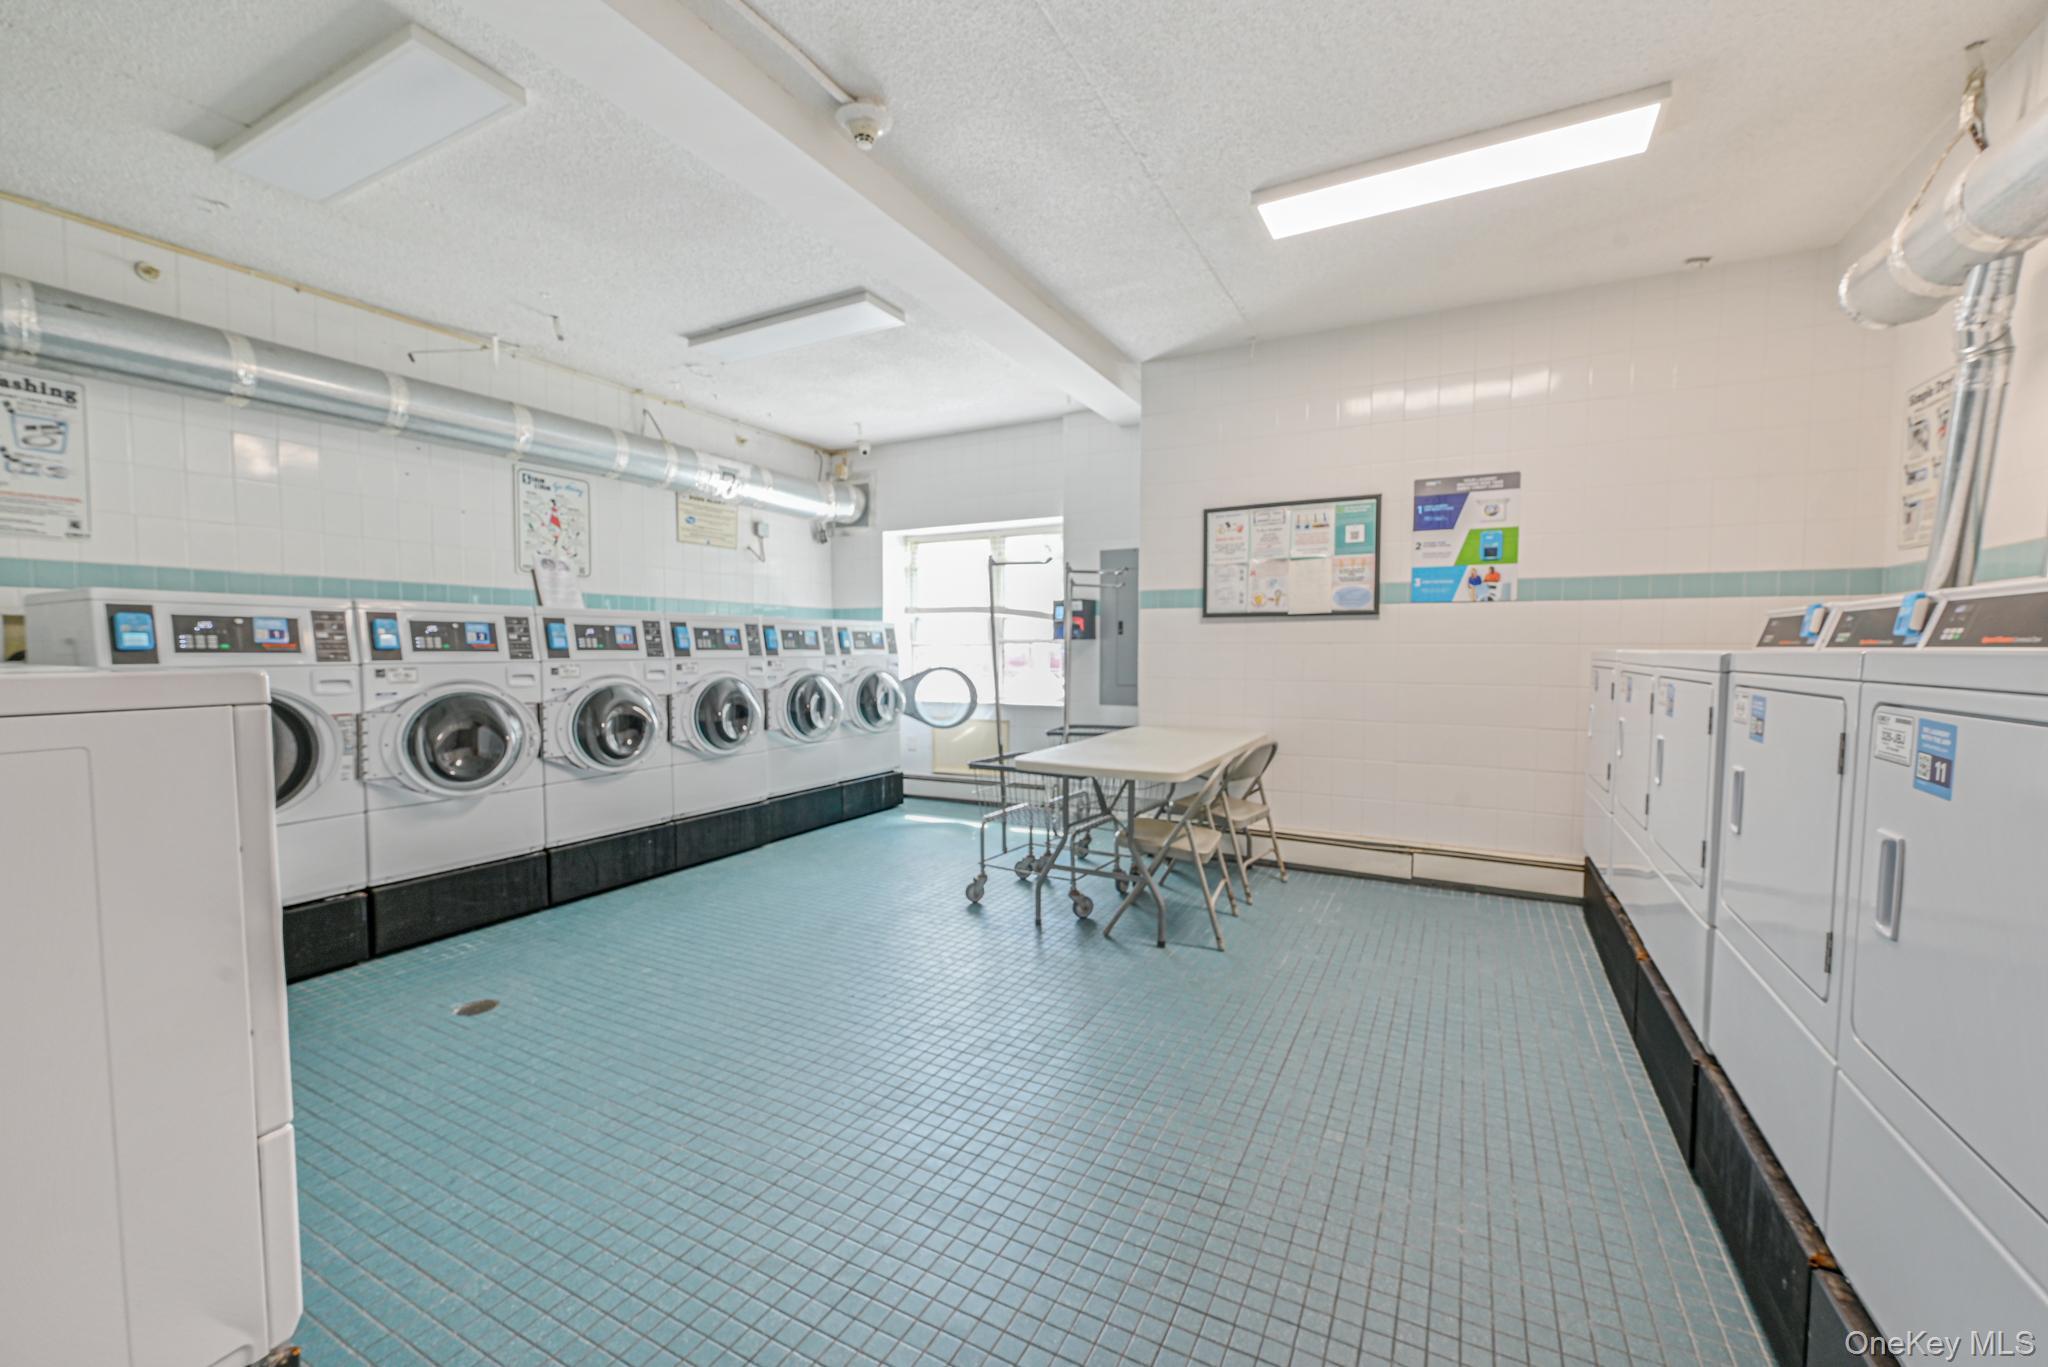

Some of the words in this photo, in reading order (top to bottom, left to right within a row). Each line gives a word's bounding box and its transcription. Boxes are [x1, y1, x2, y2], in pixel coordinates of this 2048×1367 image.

[1417, 505, 1423, 515] 1
[1415, 541, 1422, 551] 2
[1934, 761, 1948, 784] 11
